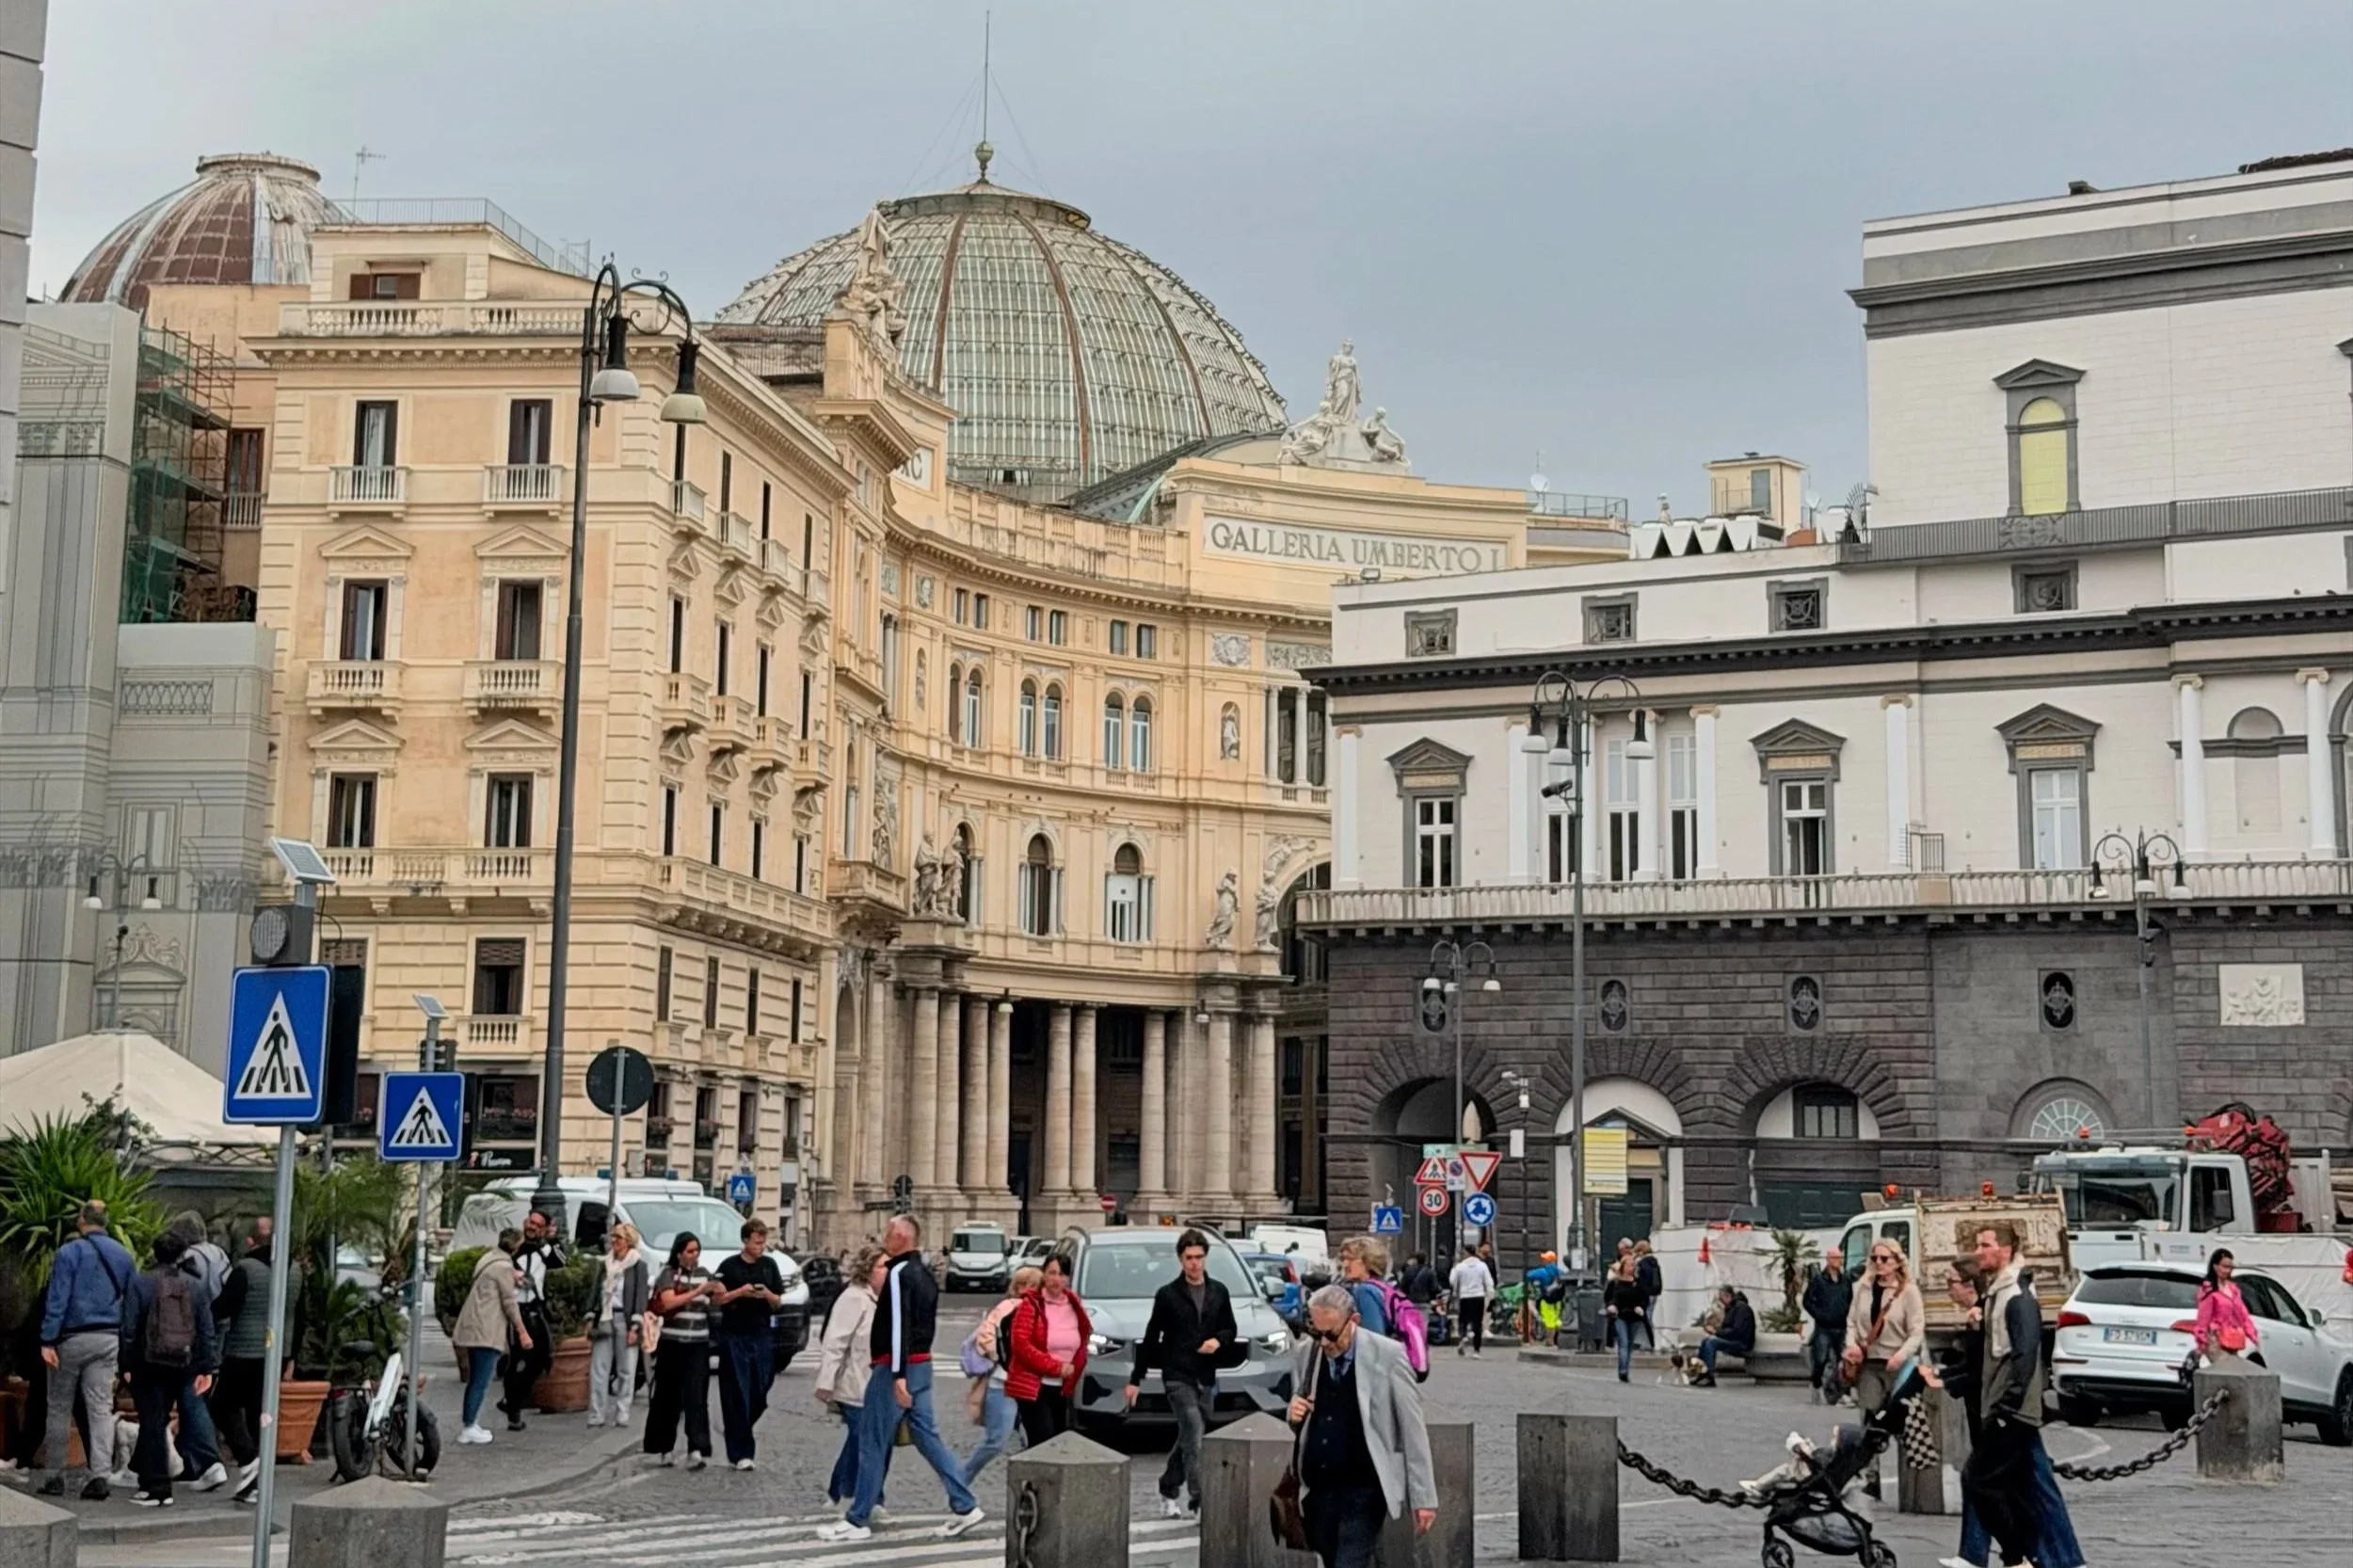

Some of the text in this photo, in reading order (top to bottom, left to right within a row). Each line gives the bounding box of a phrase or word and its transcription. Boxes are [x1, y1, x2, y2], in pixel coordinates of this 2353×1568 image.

[1210, 522, 1500, 572] GALLERIA UMBERTO I
[1426, 1193, 1442, 1208] 30
